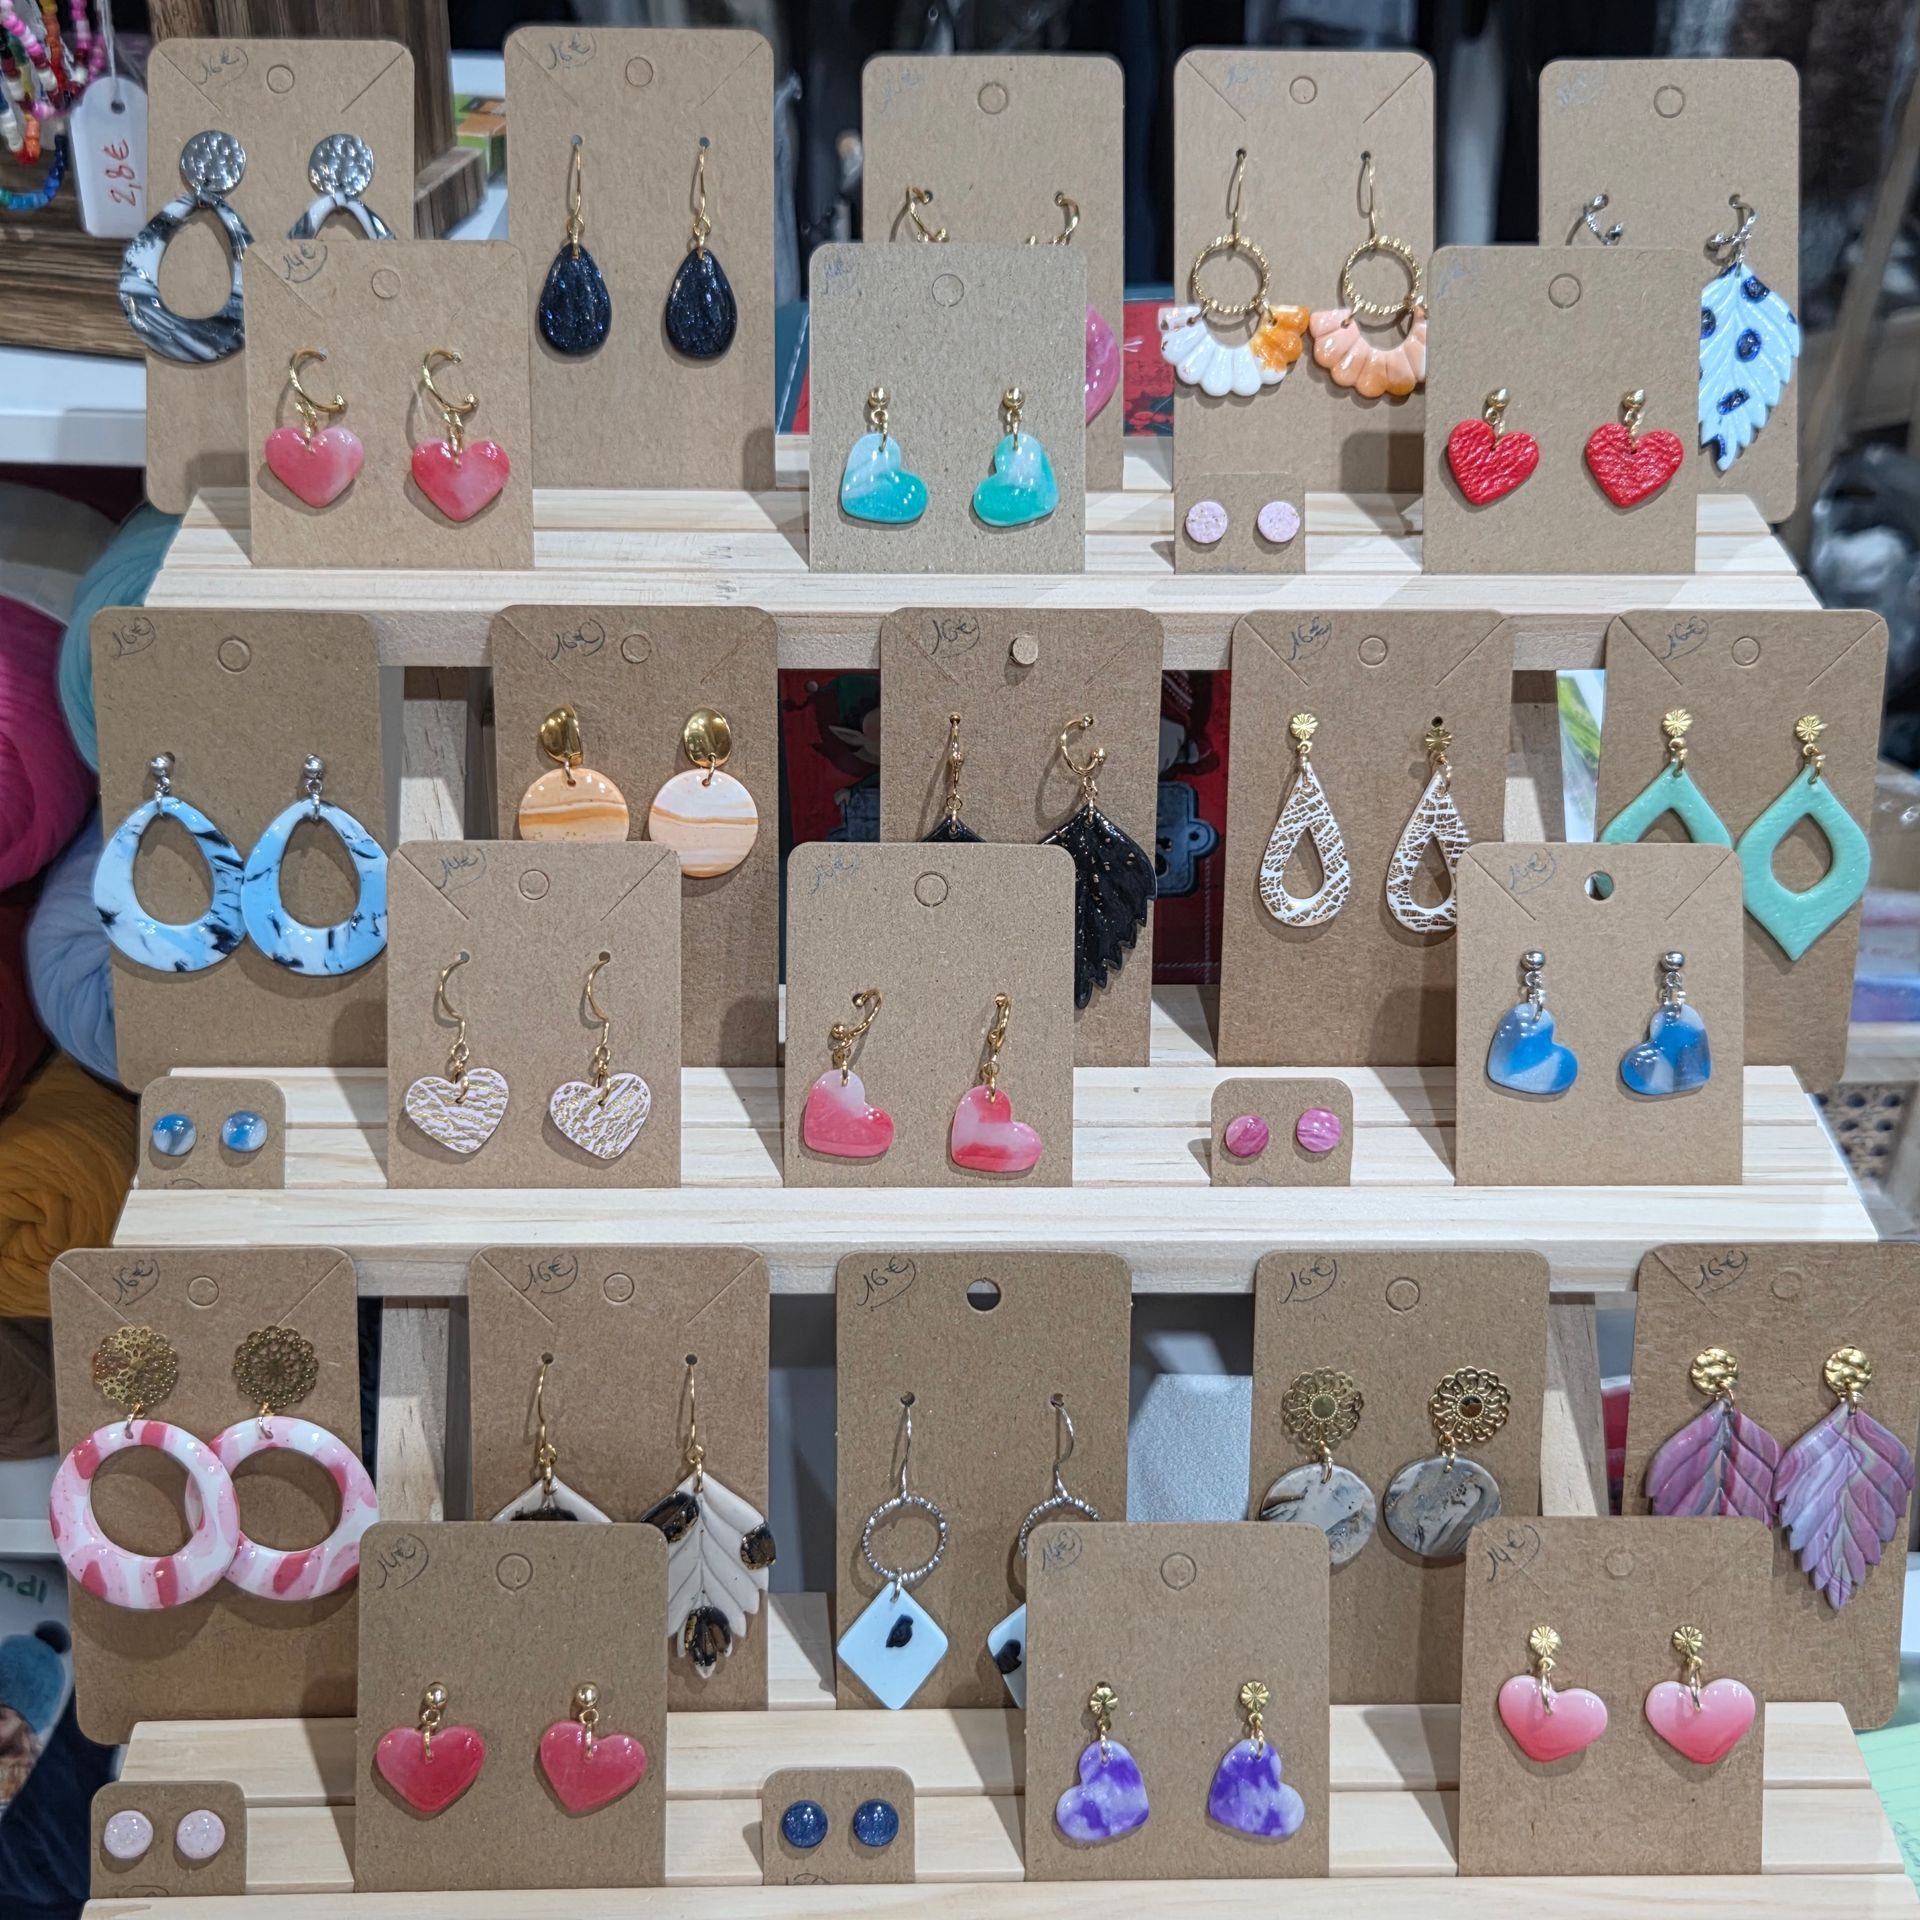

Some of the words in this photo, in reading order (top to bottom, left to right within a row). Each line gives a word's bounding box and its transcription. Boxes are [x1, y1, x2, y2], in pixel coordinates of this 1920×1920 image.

[198, 47, 240, 85] 16€
[547, 32, 591, 70] 16€
[104, 139, 142, 207] 2,8€
[283, 243, 316, 281] 14€
[111, 617, 151, 657] 16€
[551, 622, 600, 660] 16€
[932, 618, 977, 655] 16€
[1289, 616, 1329, 661] 16€
[1660, 616, 1705, 659] 16€
[112, 1260, 153, 1304] 16€
[523, 1254, 574, 1292] 16€
[856, 1255, 909, 1306] 16€
[1280, 1256, 1333, 1304] 16€
[1695, 1250, 1745, 1290] 16€
[377, 1537, 416, 1589] 14€
[1487, 1529, 1526, 1582] 14€
